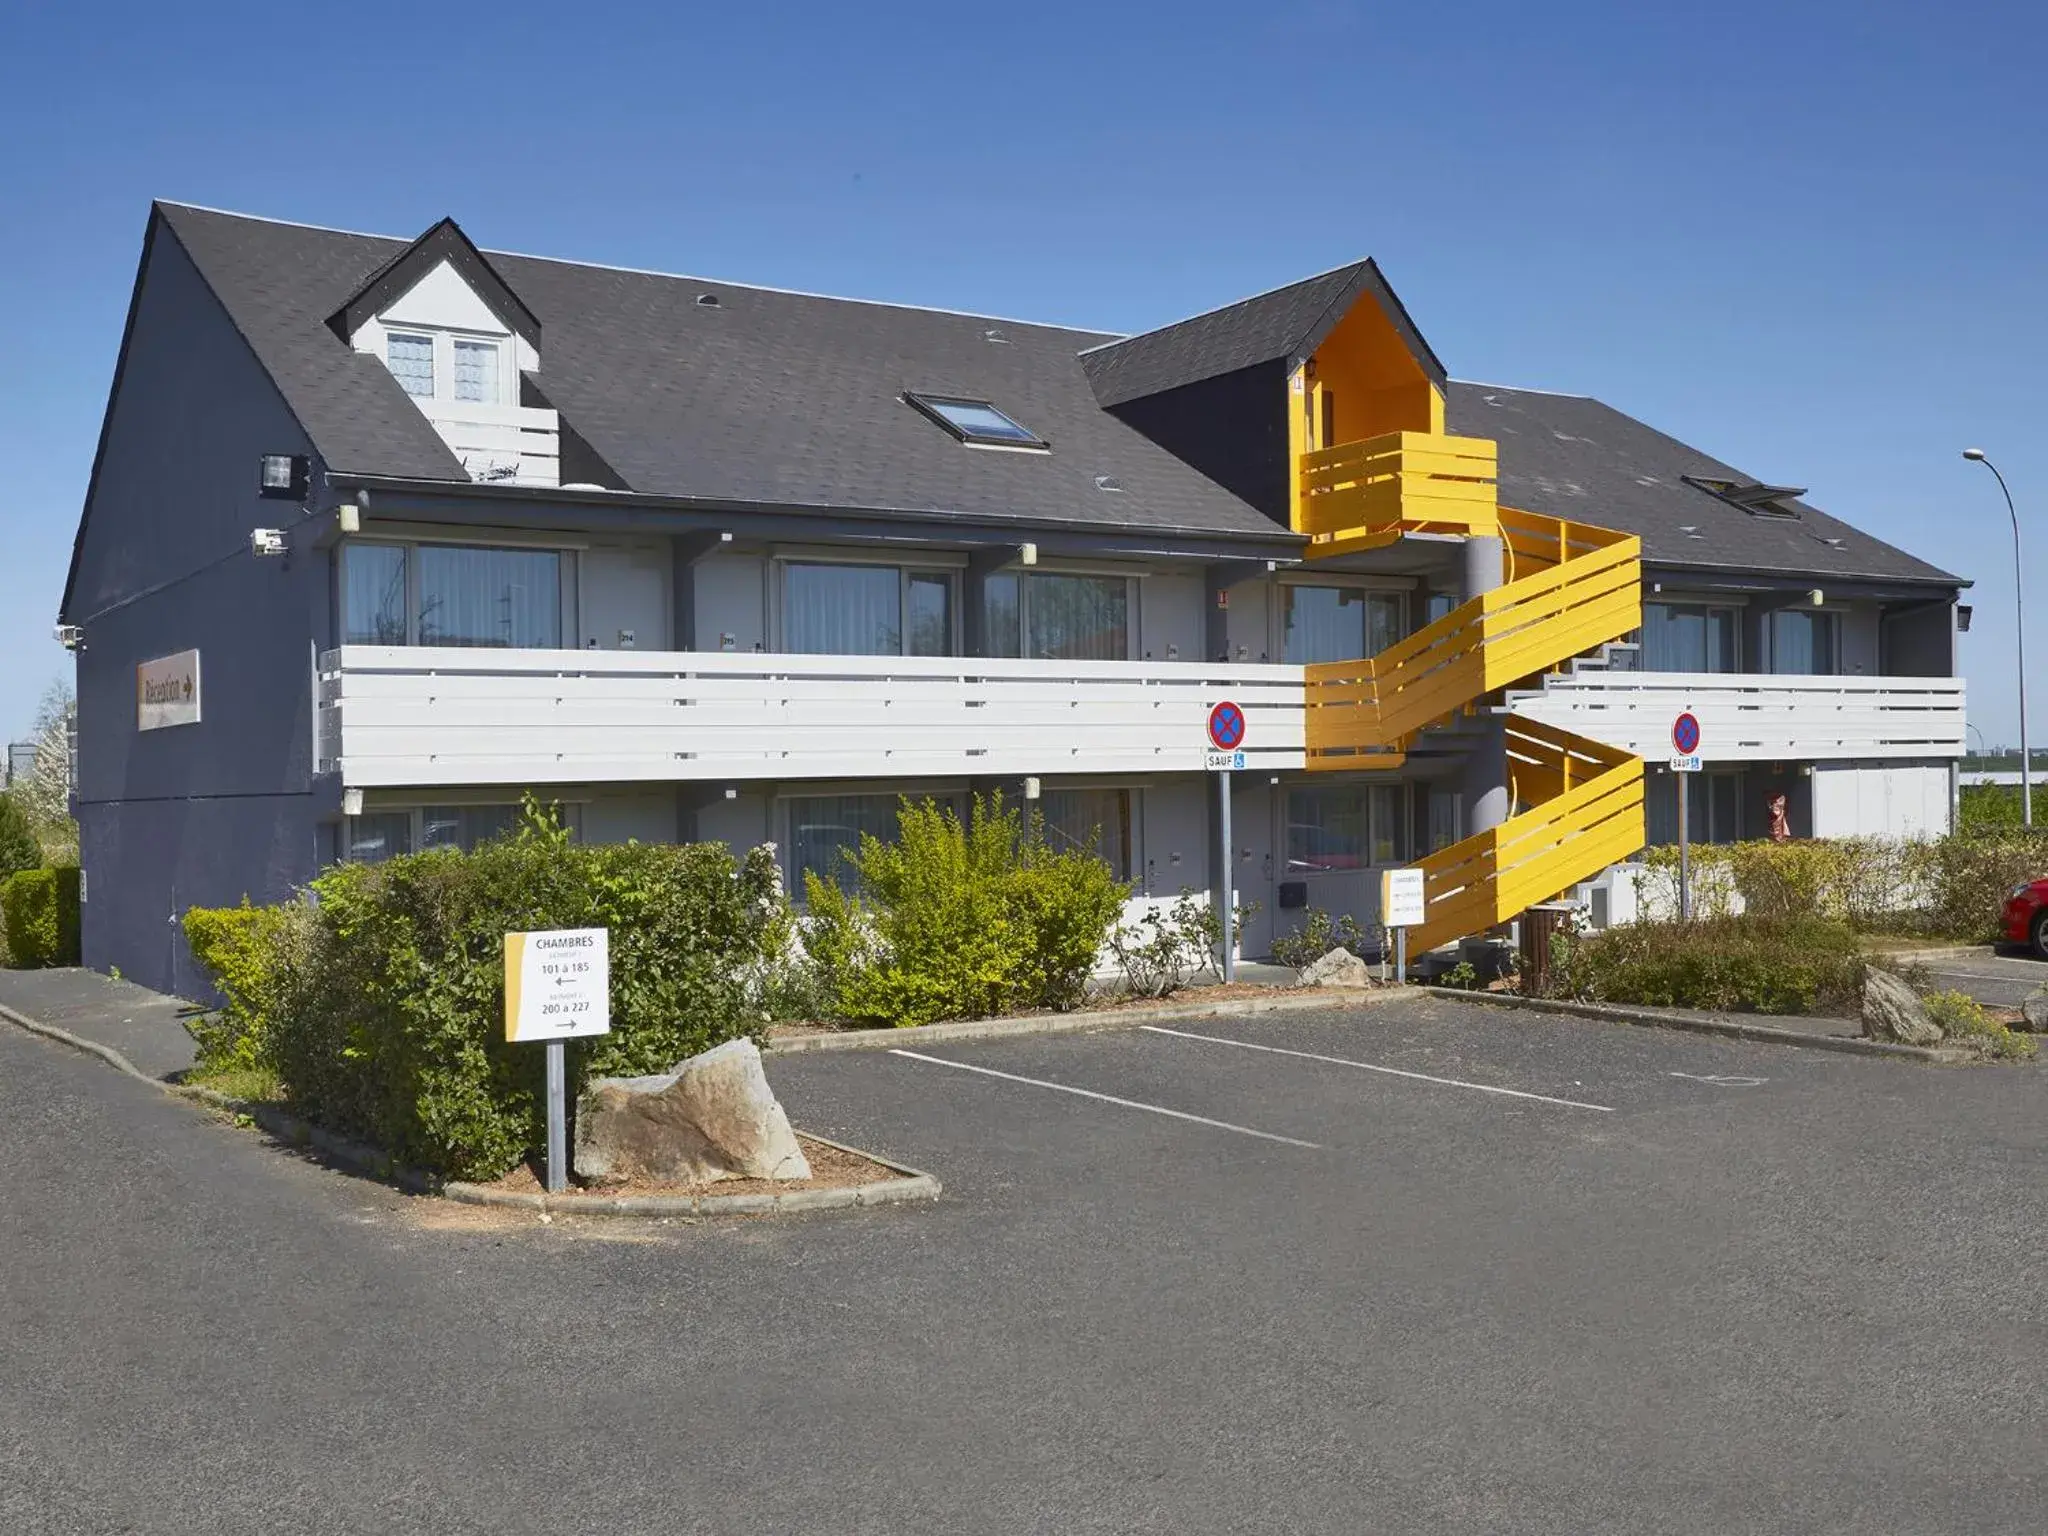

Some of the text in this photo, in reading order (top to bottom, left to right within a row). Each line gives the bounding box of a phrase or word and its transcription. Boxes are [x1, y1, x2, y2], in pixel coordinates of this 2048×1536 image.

[1208, 755, 1233, 767] SAUF
[536, 936, 594, 949] CHAMBRES
[542, 964, 559, 975] 101
[572, 962, 590, 972] 185
[542, 1004, 560, 1015] 200
[572, 1001, 590, 1012] 227
